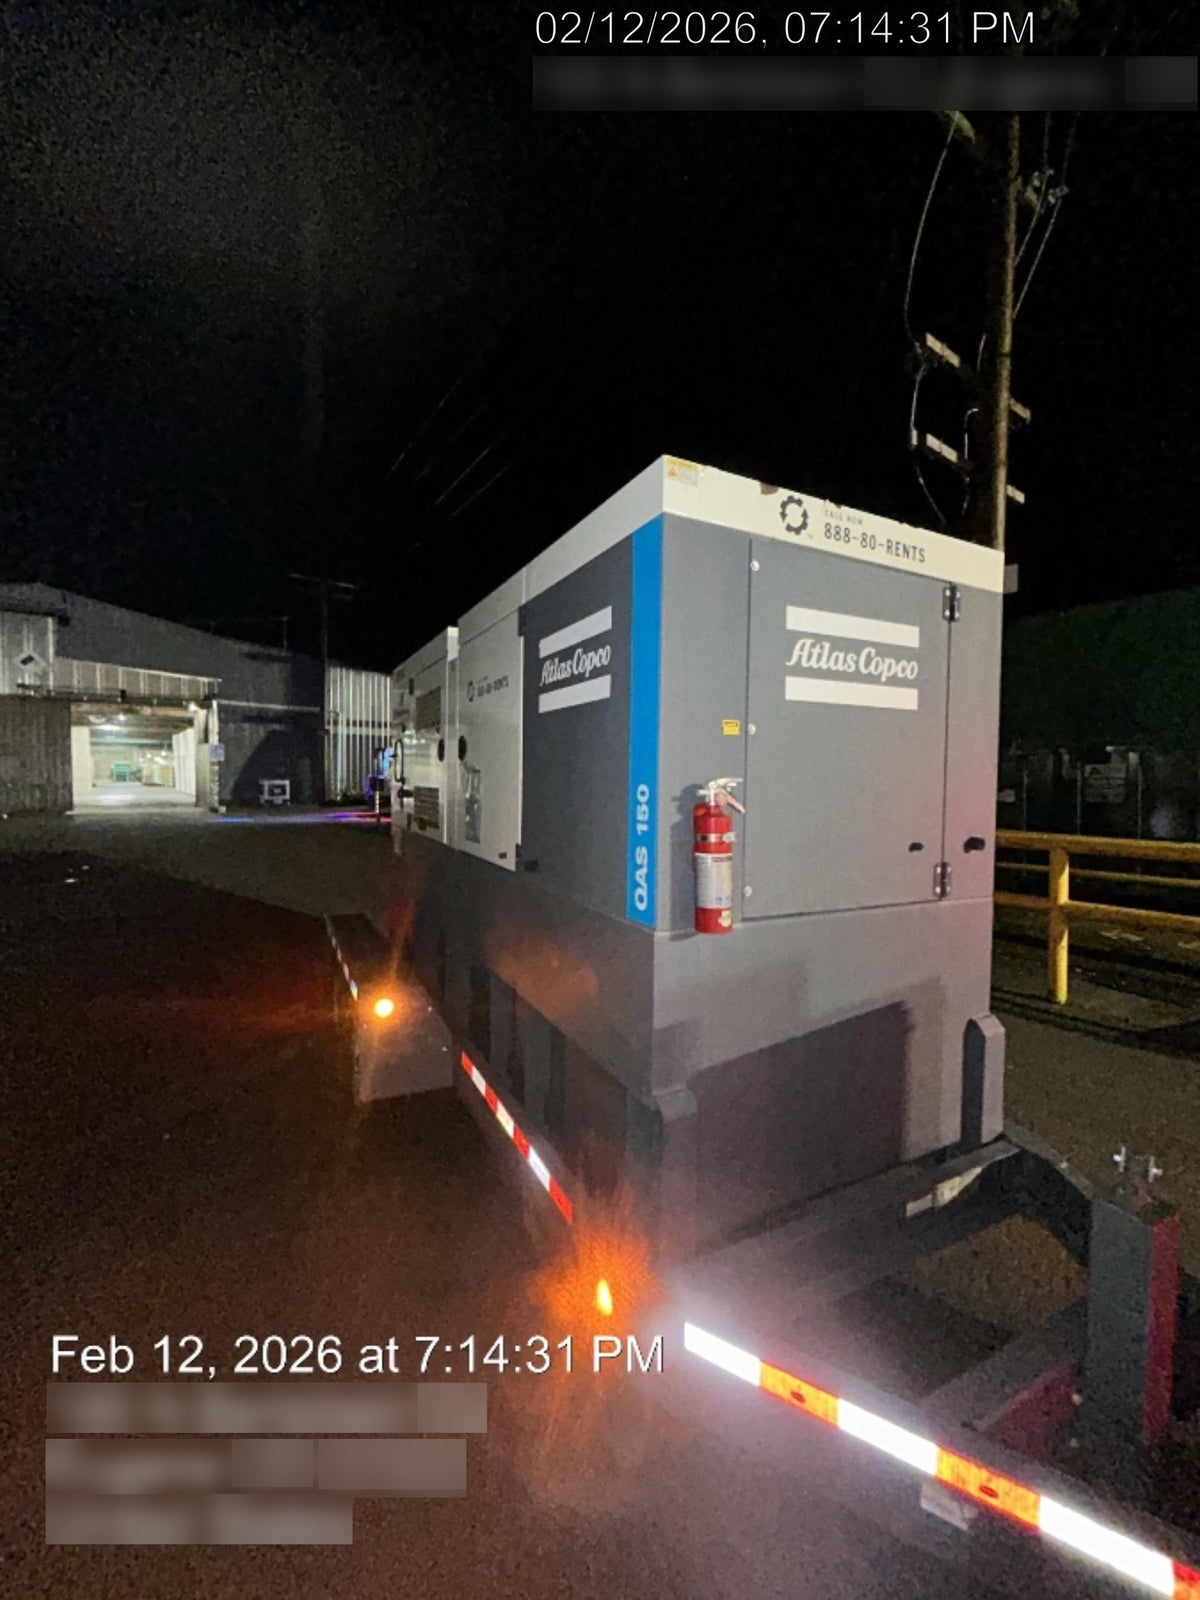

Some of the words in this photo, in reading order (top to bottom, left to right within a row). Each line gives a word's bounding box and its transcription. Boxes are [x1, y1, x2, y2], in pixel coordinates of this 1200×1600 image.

[824, 522, 926, 563] 888-80-RENTS
[539, 655, 572, 688] Atlas
[572, 644, 612, 678] Copco
[786, 638, 857, 672] Atlas
[858, 647, 918, 681] Copco
[635, 783, 651, 836] 150
[633, 847, 649, 911] QAS
